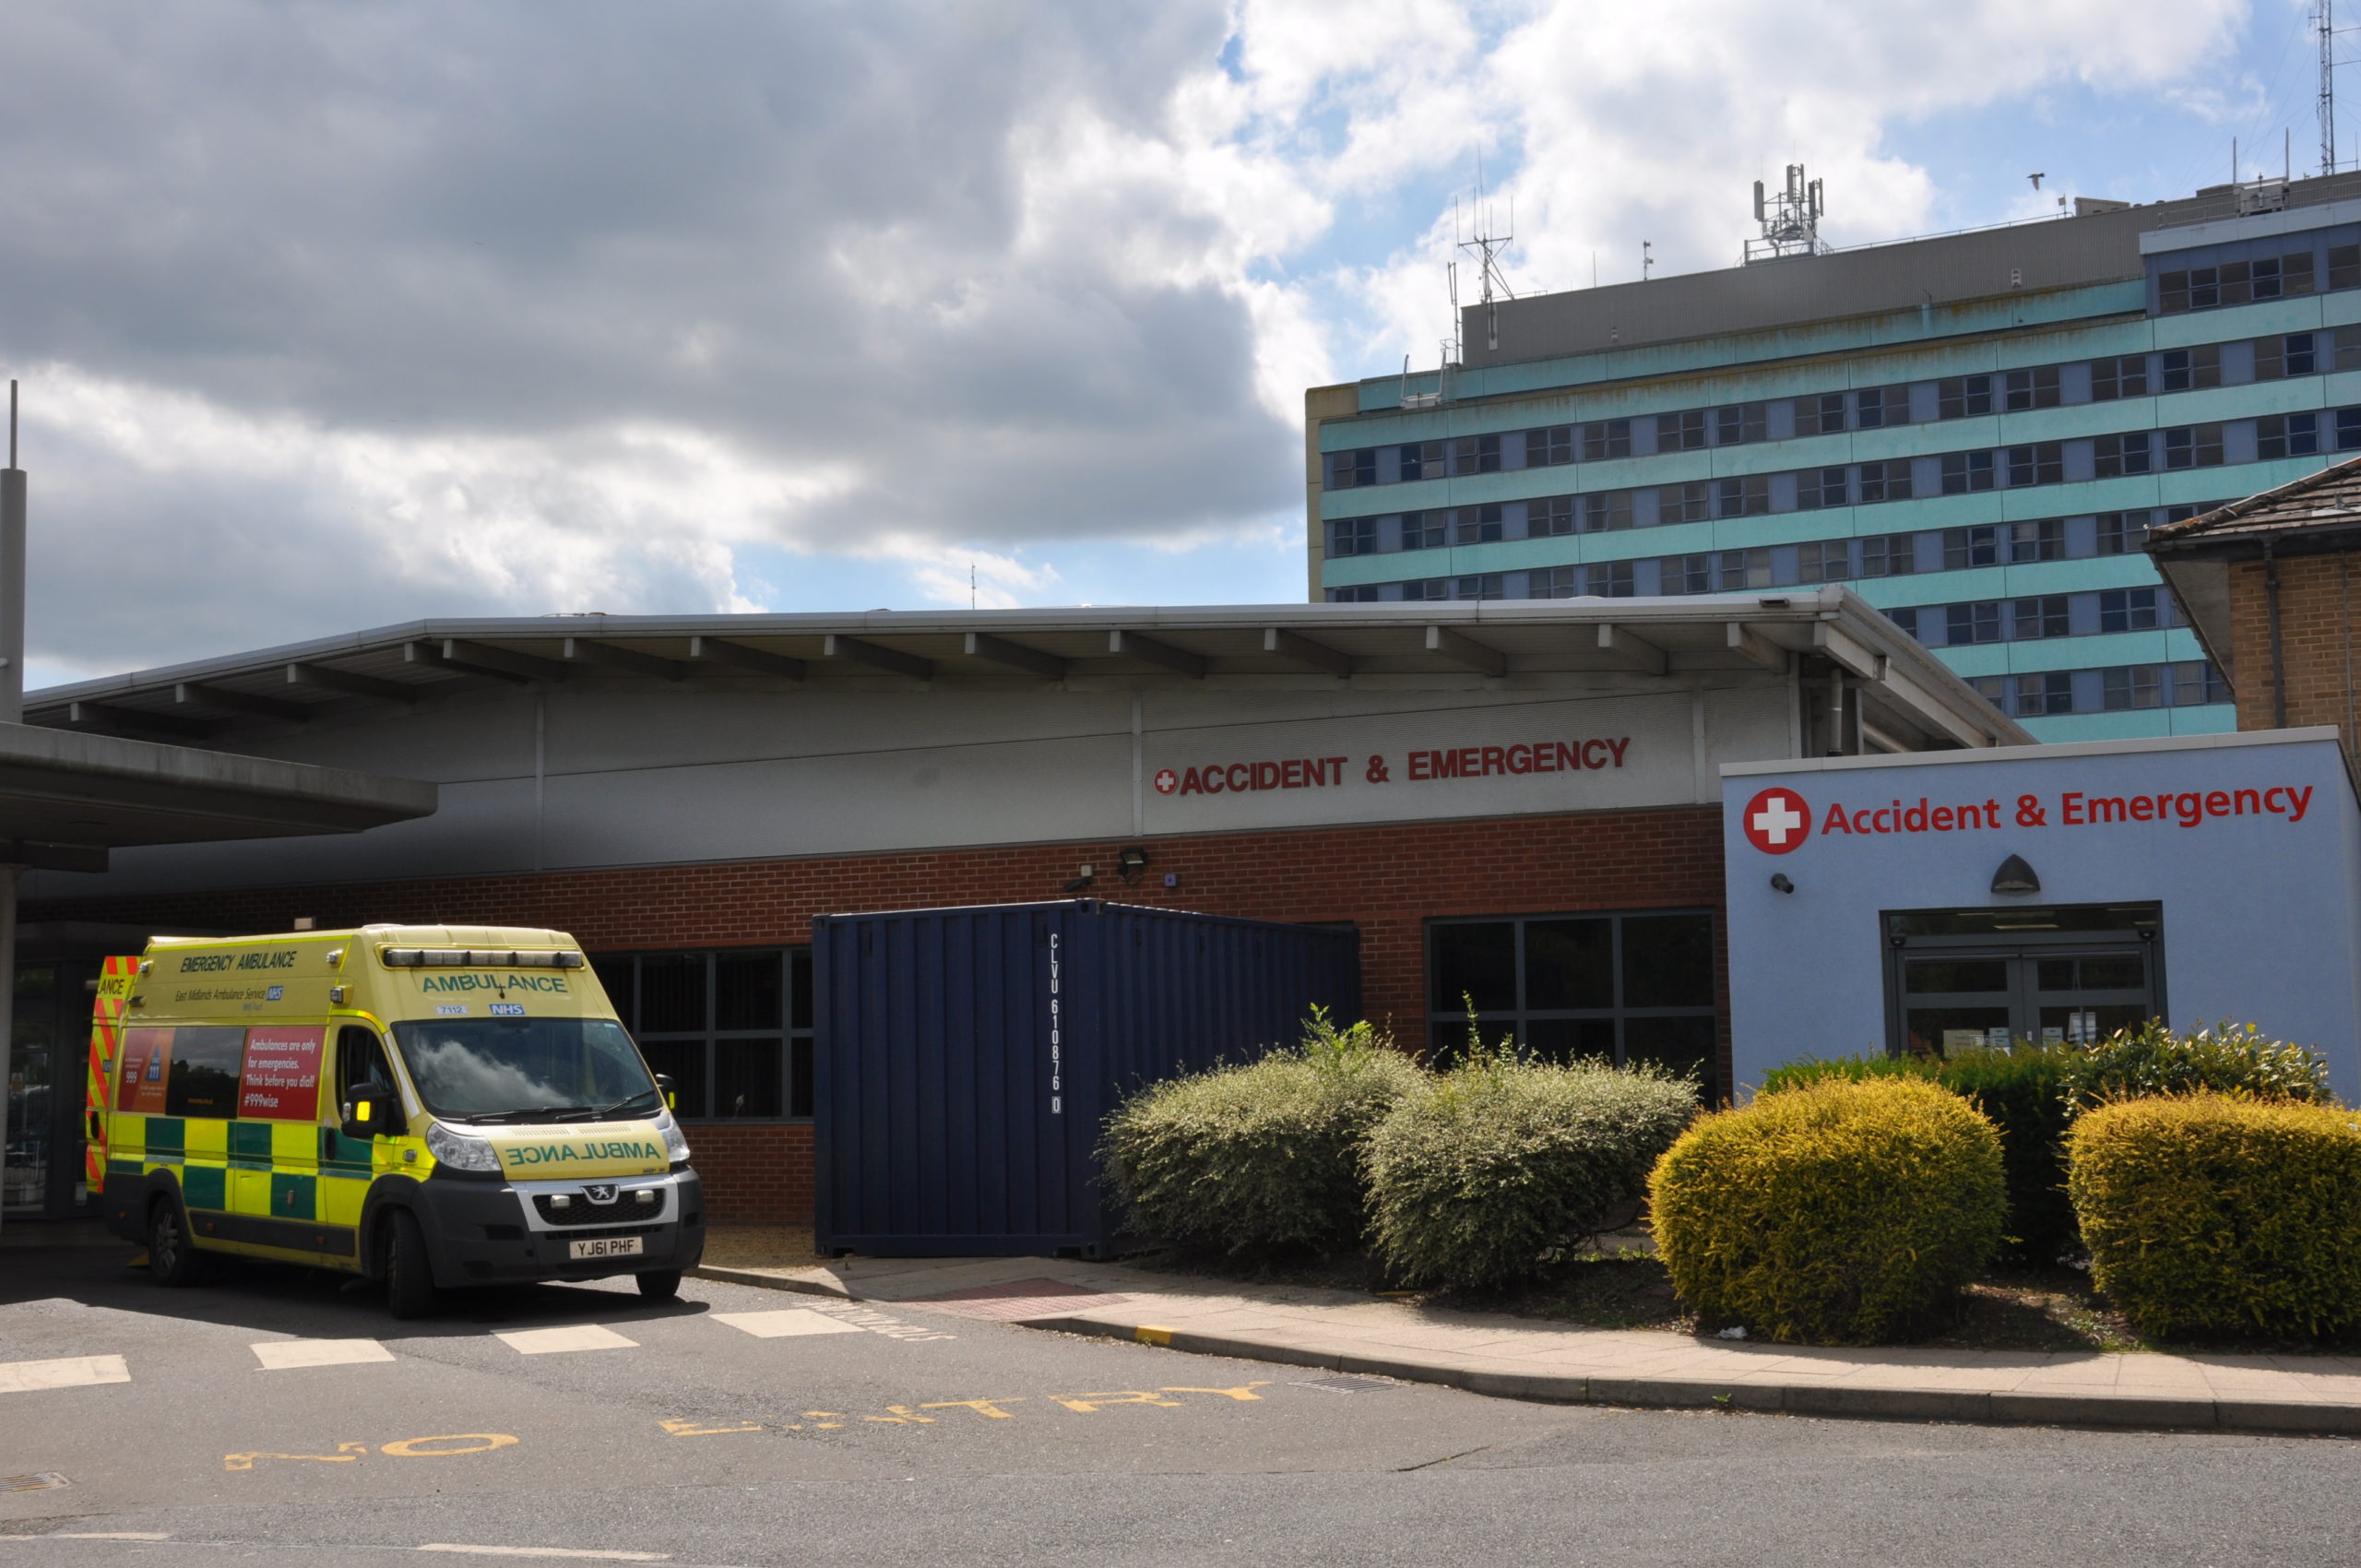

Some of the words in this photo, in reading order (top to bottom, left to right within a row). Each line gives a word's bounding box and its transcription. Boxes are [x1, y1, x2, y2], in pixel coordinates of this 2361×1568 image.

[1180, 756, 1348, 796] ACCIDENT
[1366, 754, 1391, 784] &
[1408, 738, 1631, 780] EMERGENCY
[1821, 798, 2001, 836] Accident
[2015, 793, 2047, 827] &
[2061, 785, 2314, 828] Emergency
[180, 954, 235, 973] EMERGENCY
[237, 950, 298, 970] AMBULANCE
[1050, 933, 1059, 994] CLVU
[422, 974, 569, 993] AMBULANCE
[174, 990, 188, 1002] East
[188, 988, 212, 1001] Midlands
[212, 987, 244, 1001] Ambulance
[244, 988, 266, 1000] Service
[267, 986, 283, 1001] NHS
[491, 1004, 524, 1015] NHS
[250, 1039, 288, 1051] Ambulances
[289, 1042, 301, 1051] are
[302, 1039, 316, 1054] only
[1050, 999, 1061, 1091] 610876
[247, 1056, 257, 1068] for
[258, 1057, 300, 1072] emergencies.
[246, 1074, 264, 1086] Think
[265, 1074, 286, 1087] before
[286, 1077, 297, 1090] you
[299, 1075, 315, 1087] dial!
[243, 1093, 279, 1108] #999wise
[577, 1241, 608, 1256] YJ61
[610, 1239, 635, 1253] PHF
